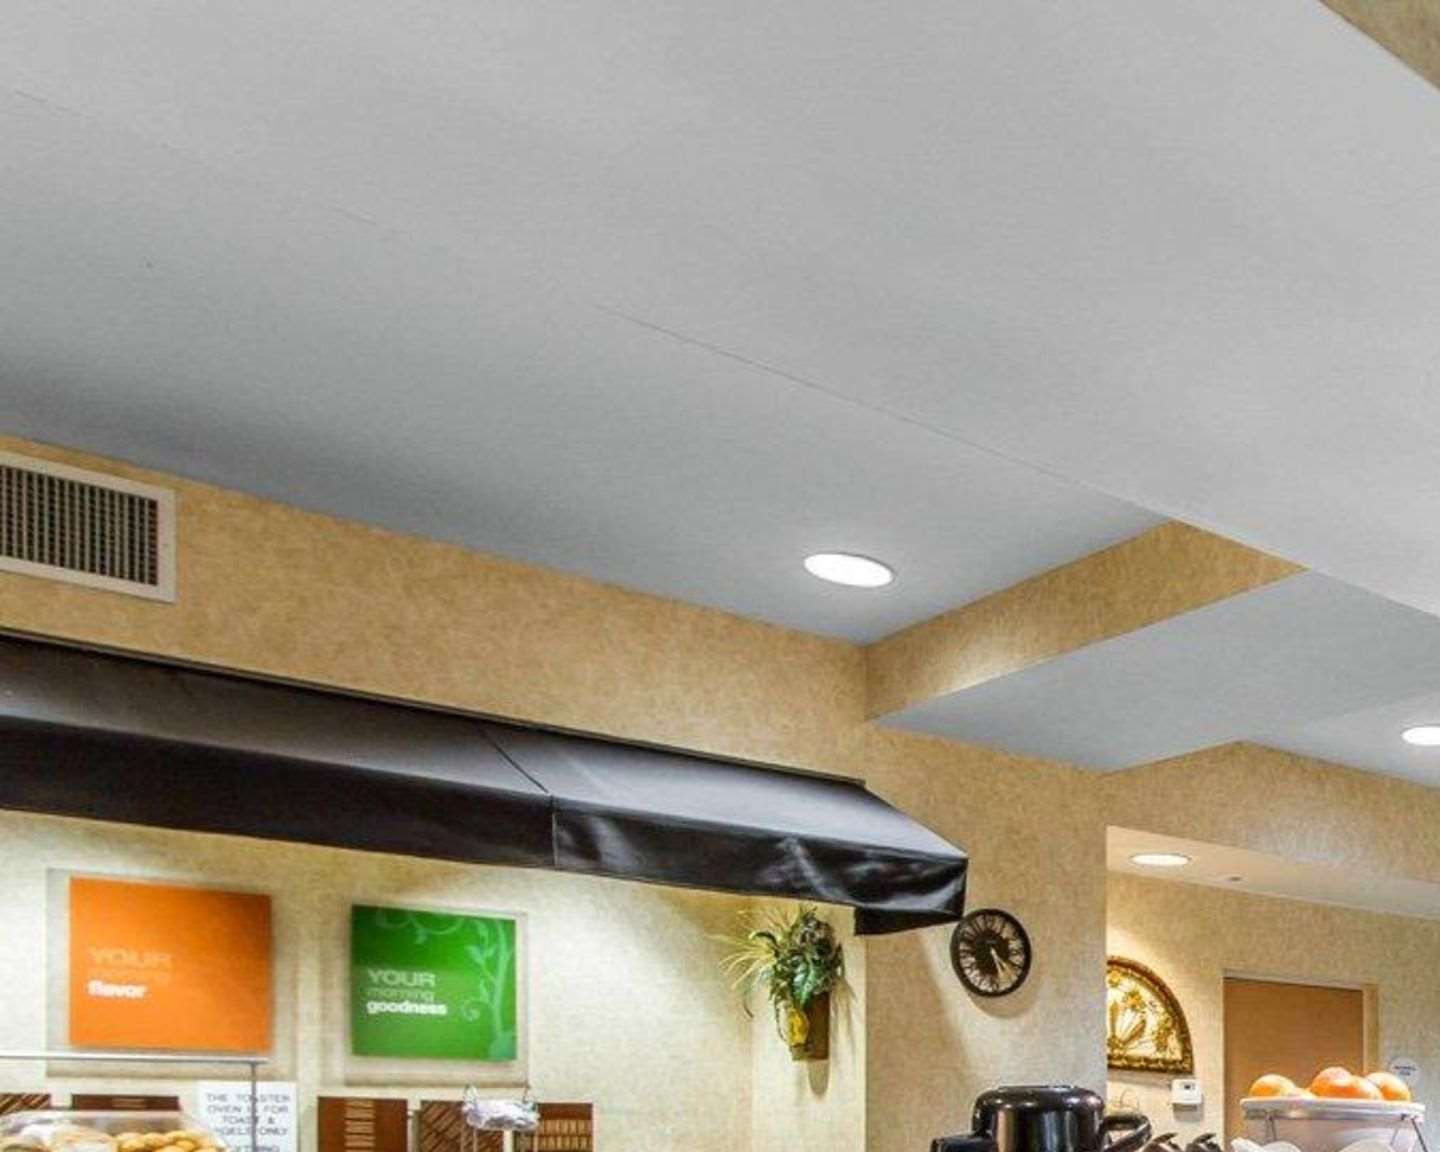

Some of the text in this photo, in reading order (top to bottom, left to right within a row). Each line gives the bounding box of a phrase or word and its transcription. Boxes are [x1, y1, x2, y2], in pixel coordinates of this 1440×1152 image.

[368, 968, 436, 987] YOUR
[87, 979, 148, 998] flavor
[366, 1000, 447, 1015] goodness
[236, 1093, 290, 1103] TOSTER
